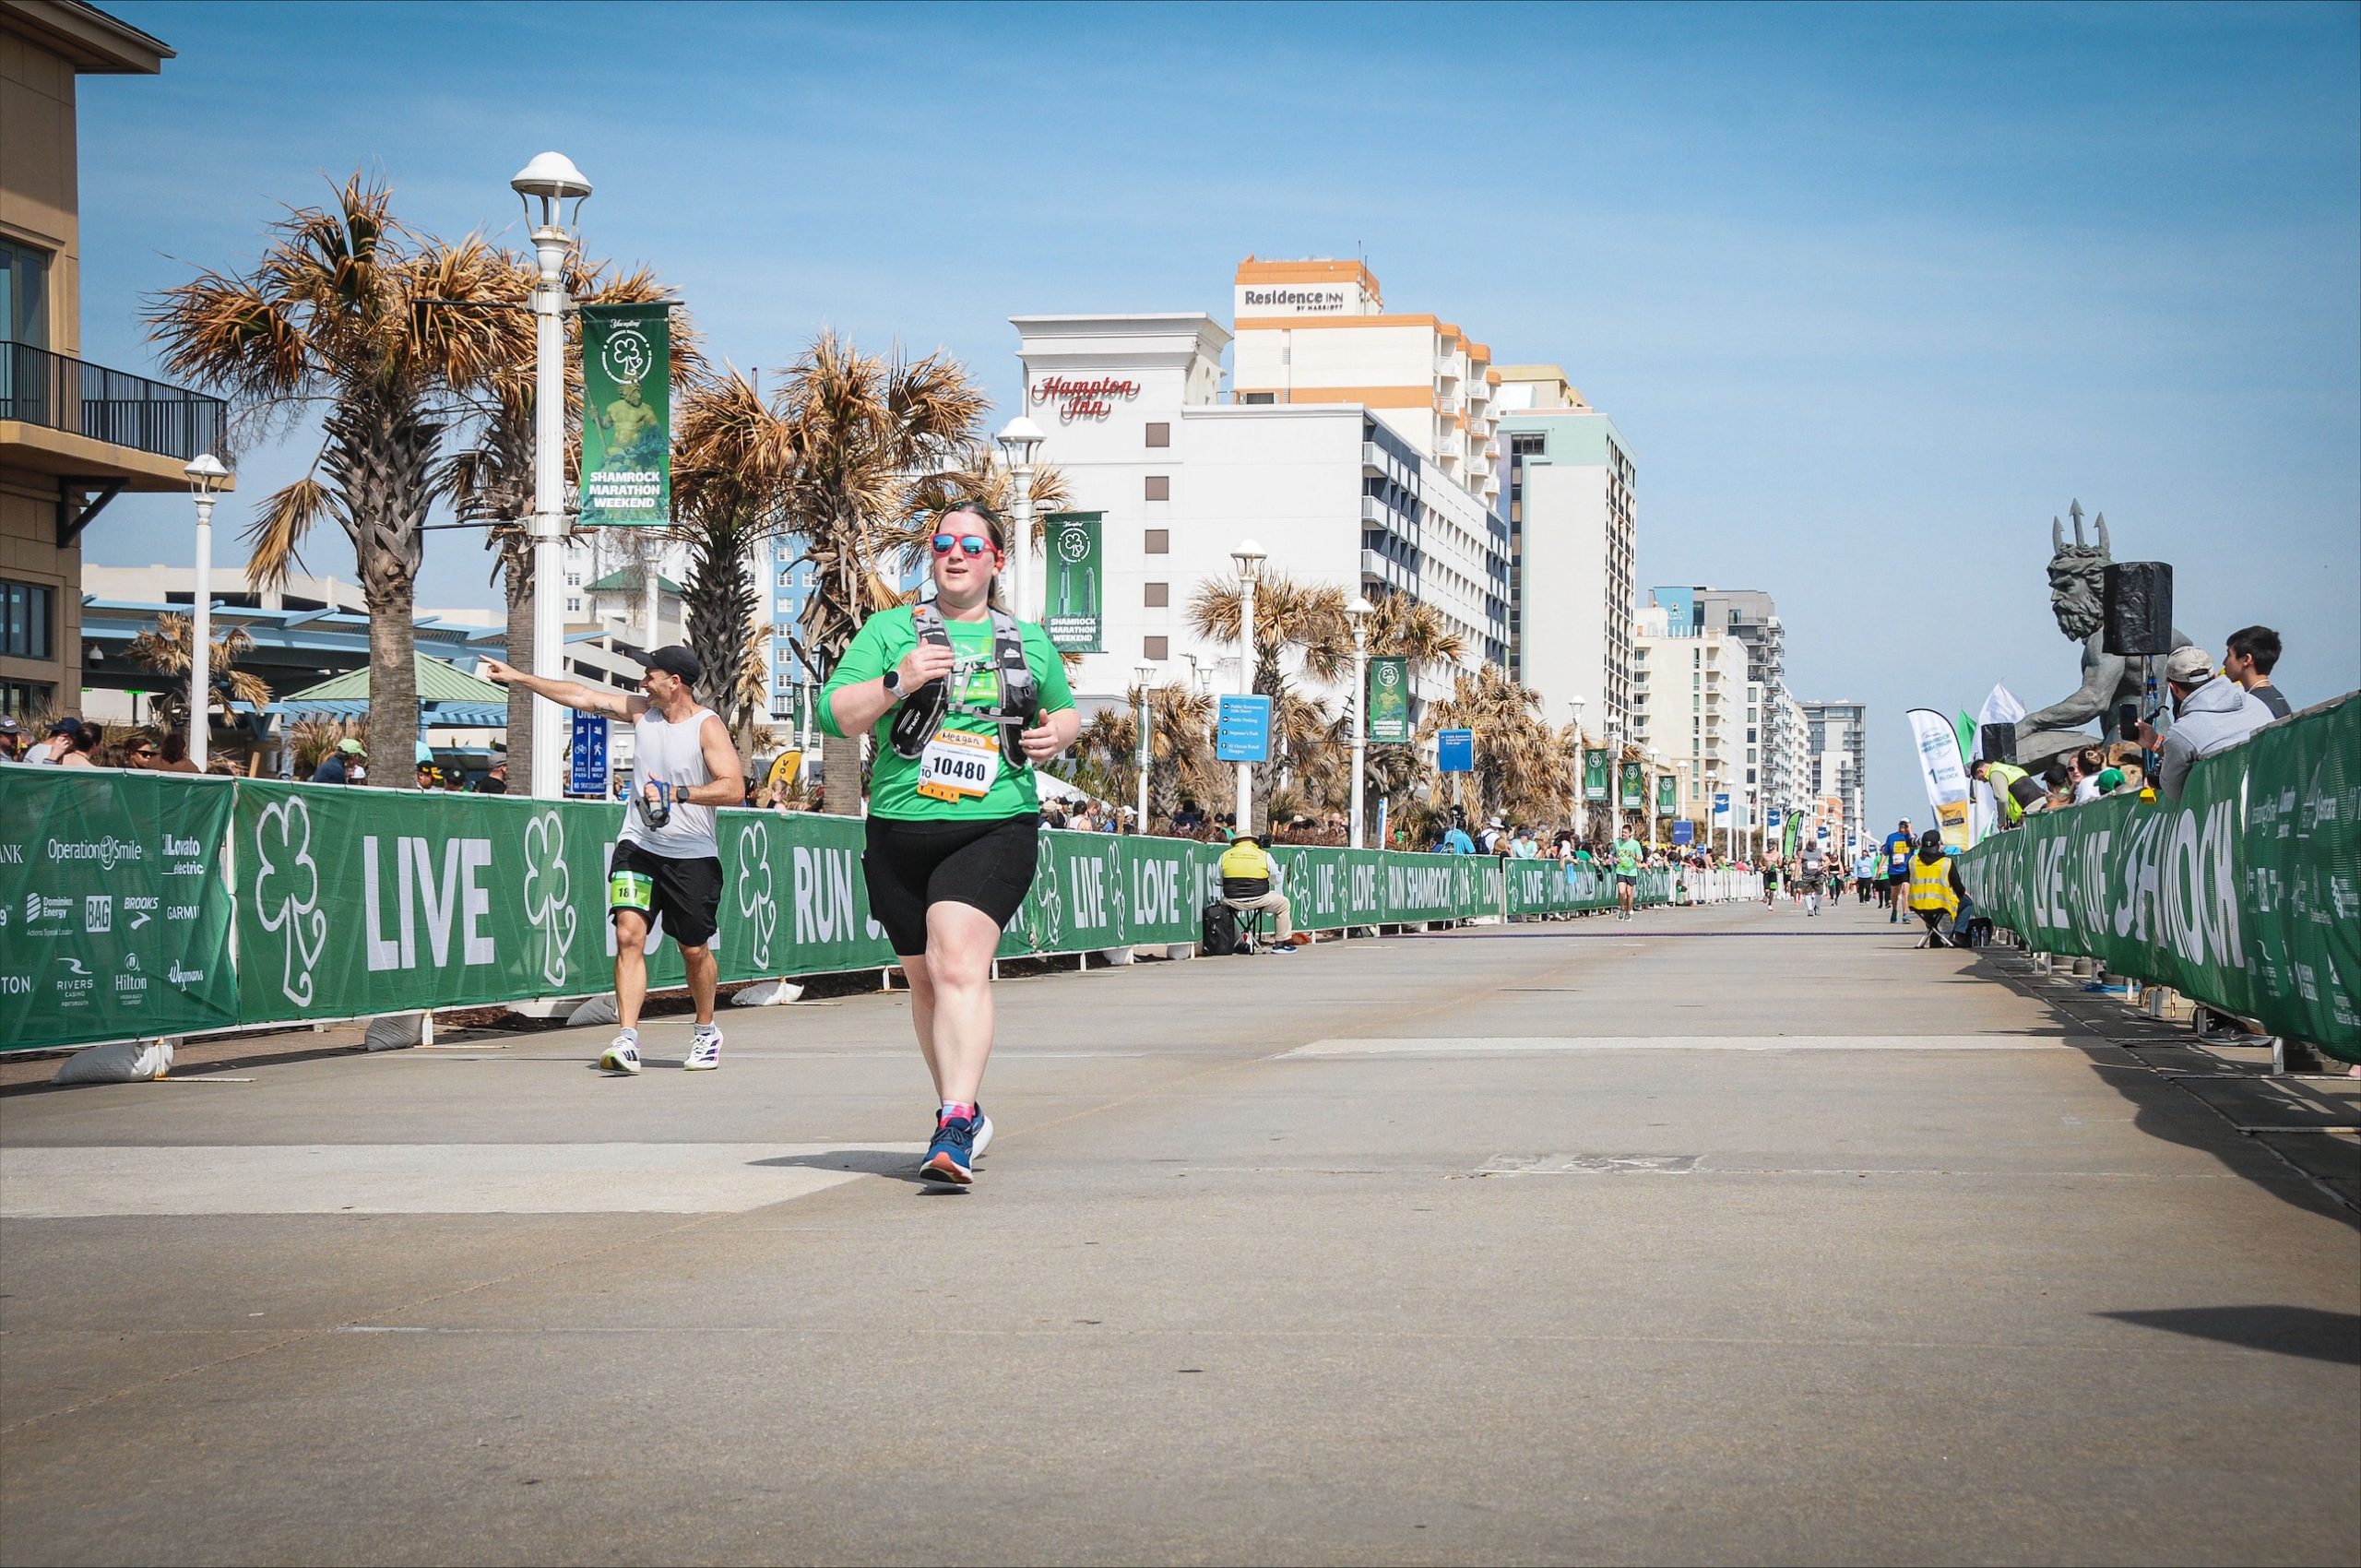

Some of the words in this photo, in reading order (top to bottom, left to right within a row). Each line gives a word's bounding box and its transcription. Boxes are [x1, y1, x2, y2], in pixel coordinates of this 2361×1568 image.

[1245, 290, 1323, 305] Residence
[1325, 292, 1344, 303] INN
[1031, 376, 1140, 400] Hampton
[1062, 396, 1111, 420] Inn
[589, 471, 660, 482] SHAMROCK
[589, 484, 660, 495] MARATHON
[594, 497, 655, 508] WEEKEND
[943, 731, 980, 746] Meagan
[933, 756, 986, 781] 10480
[1928, 768, 1938, 784] 1
[48, 838, 101, 864] Operation
[113, 839, 142, 860] Smile
[162, 834, 201, 856] Lovato
[173, 861, 204, 874] electric
[793, 846, 854, 946] RUN
[1070, 856, 1107, 928] LIVE
[1133, 858, 1179, 925] LOVE
[1315, 863, 1335, 914] LIVE
[1351, 864, 1376, 911] LOVE
[1388, 865, 1404, 909] RUN
[1522, 870, 1544, 905] LIVE
[43, 897, 73, 906] Dominion
[124, 897, 159, 909] BROOKS
[167, 906, 200, 920] GARMI
[363, 836, 494, 971] LIVE
[43, 908, 67, 919] Energy
[88, 900, 110, 928] BAG
[57, 979, 93, 991] RIVERS
[115, 975, 148, 991] Hilton
[168, 959, 204, 992] Wegmans
